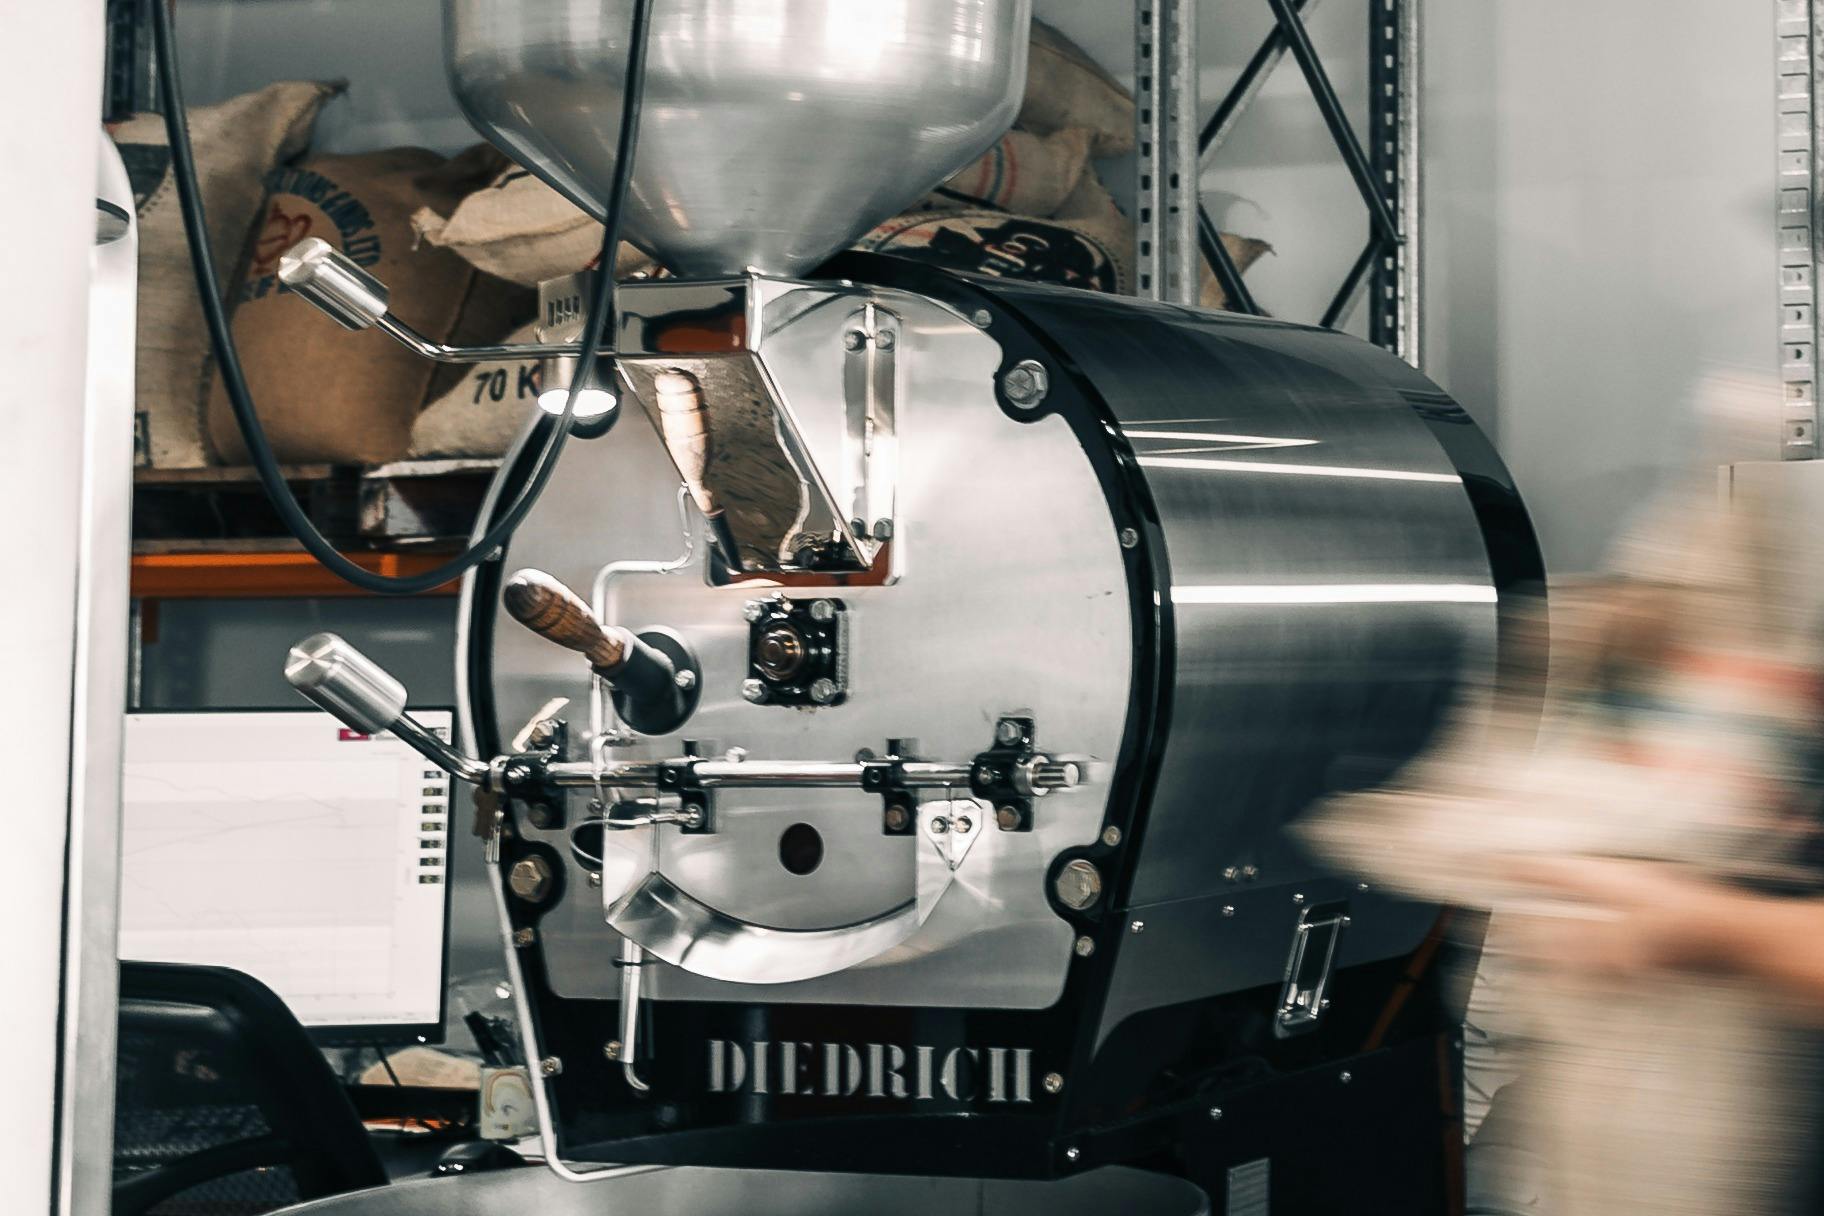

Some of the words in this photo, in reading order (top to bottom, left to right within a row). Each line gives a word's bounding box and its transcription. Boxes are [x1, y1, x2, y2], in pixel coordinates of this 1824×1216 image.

[474, 368, 507, 404] 70
[517, 363, 543, 400] K
[708, 1040, 1033, 1102] DIEDRICH
